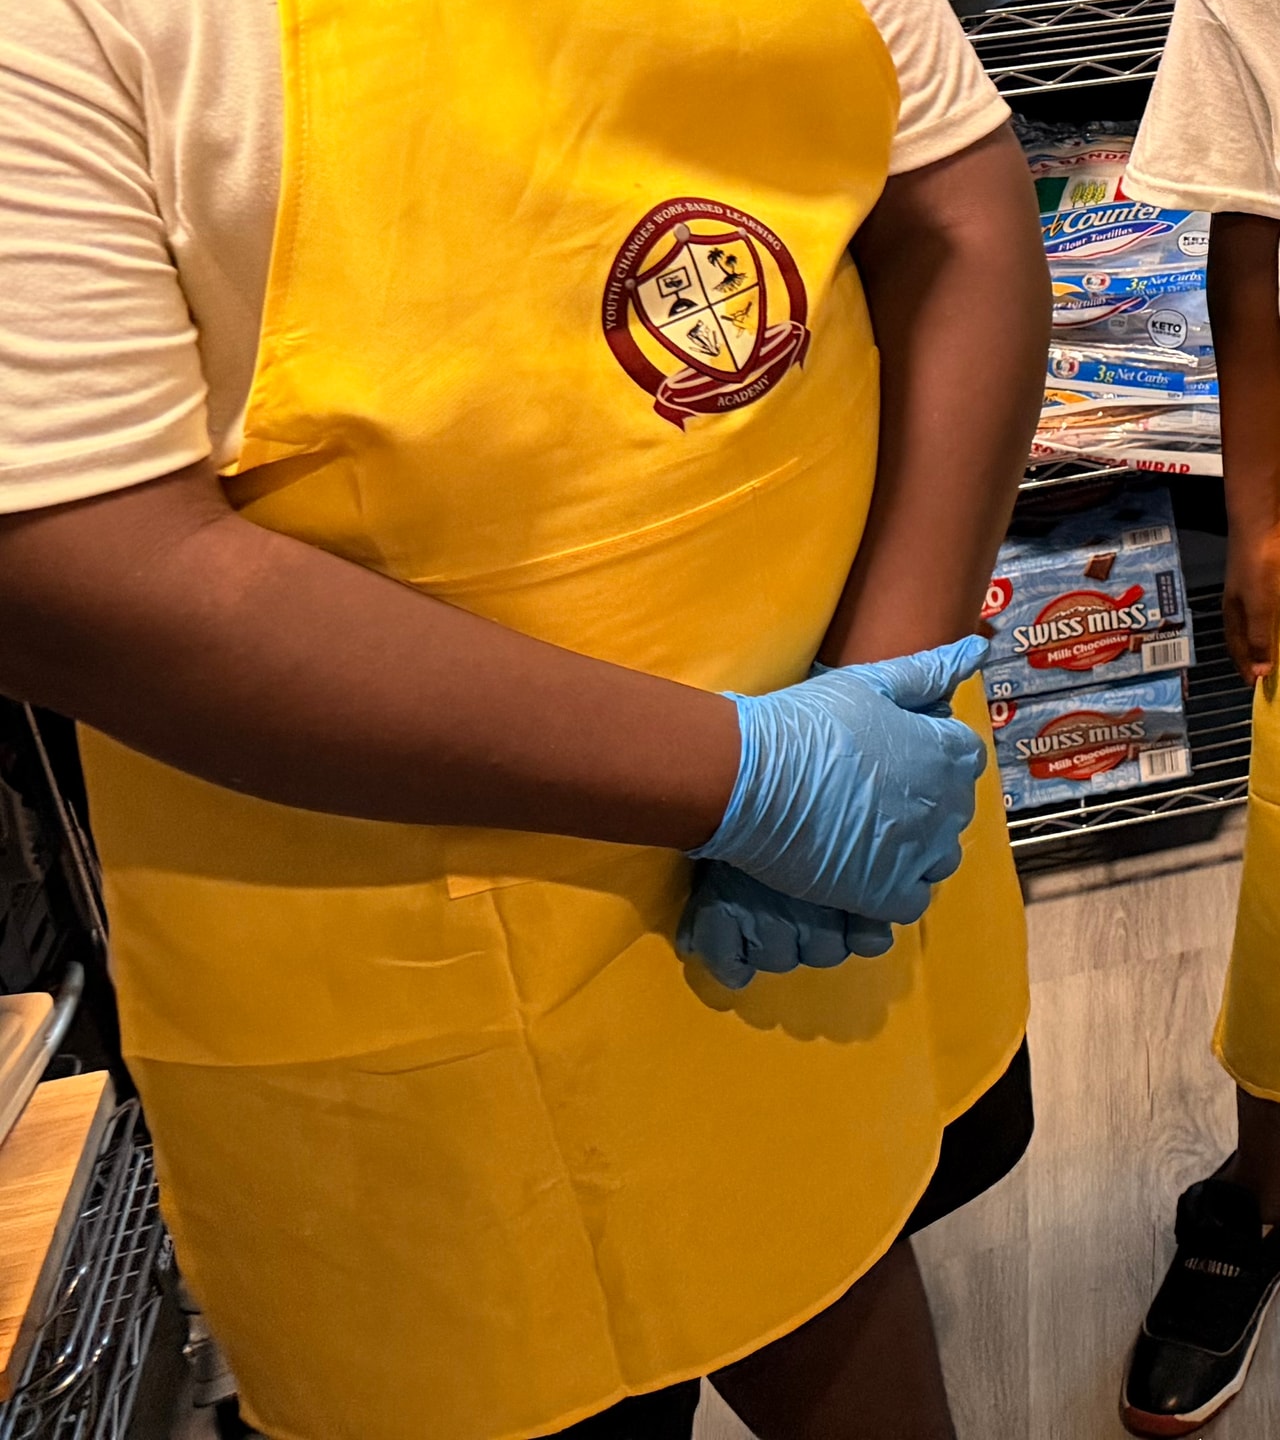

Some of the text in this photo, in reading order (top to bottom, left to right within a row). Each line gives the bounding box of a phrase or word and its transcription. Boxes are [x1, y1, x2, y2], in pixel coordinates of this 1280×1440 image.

[1058, 227, 1134, 252] Flour Tortillas
[605, 202, 781, 330] YOUTH CHANGES WORK-BASED LEARNING
[1126, 277, 1148, 291] 3g
[1148, 276, 1168, 286] Net
[1169, 272, 1203, 283] Carbs
[1151, 320, 1182, 333] KETO
[1094, 364, 1171, 386] 3g Net Carbs
[717, 375, 769, 407] ACADEMY
[1136, 459, 1191, 474] WRAP
[1013, 616, 1084, 653] SWISS
[1047, 635, 1128, 662] Milk Chocolate
[992, 681, 1012, 697] 50
[1015, 730, 1085, 759] SWISS
[1048, 758, 1072, 773] Milk
[1072, 744, 1127, 765] Chocolate
